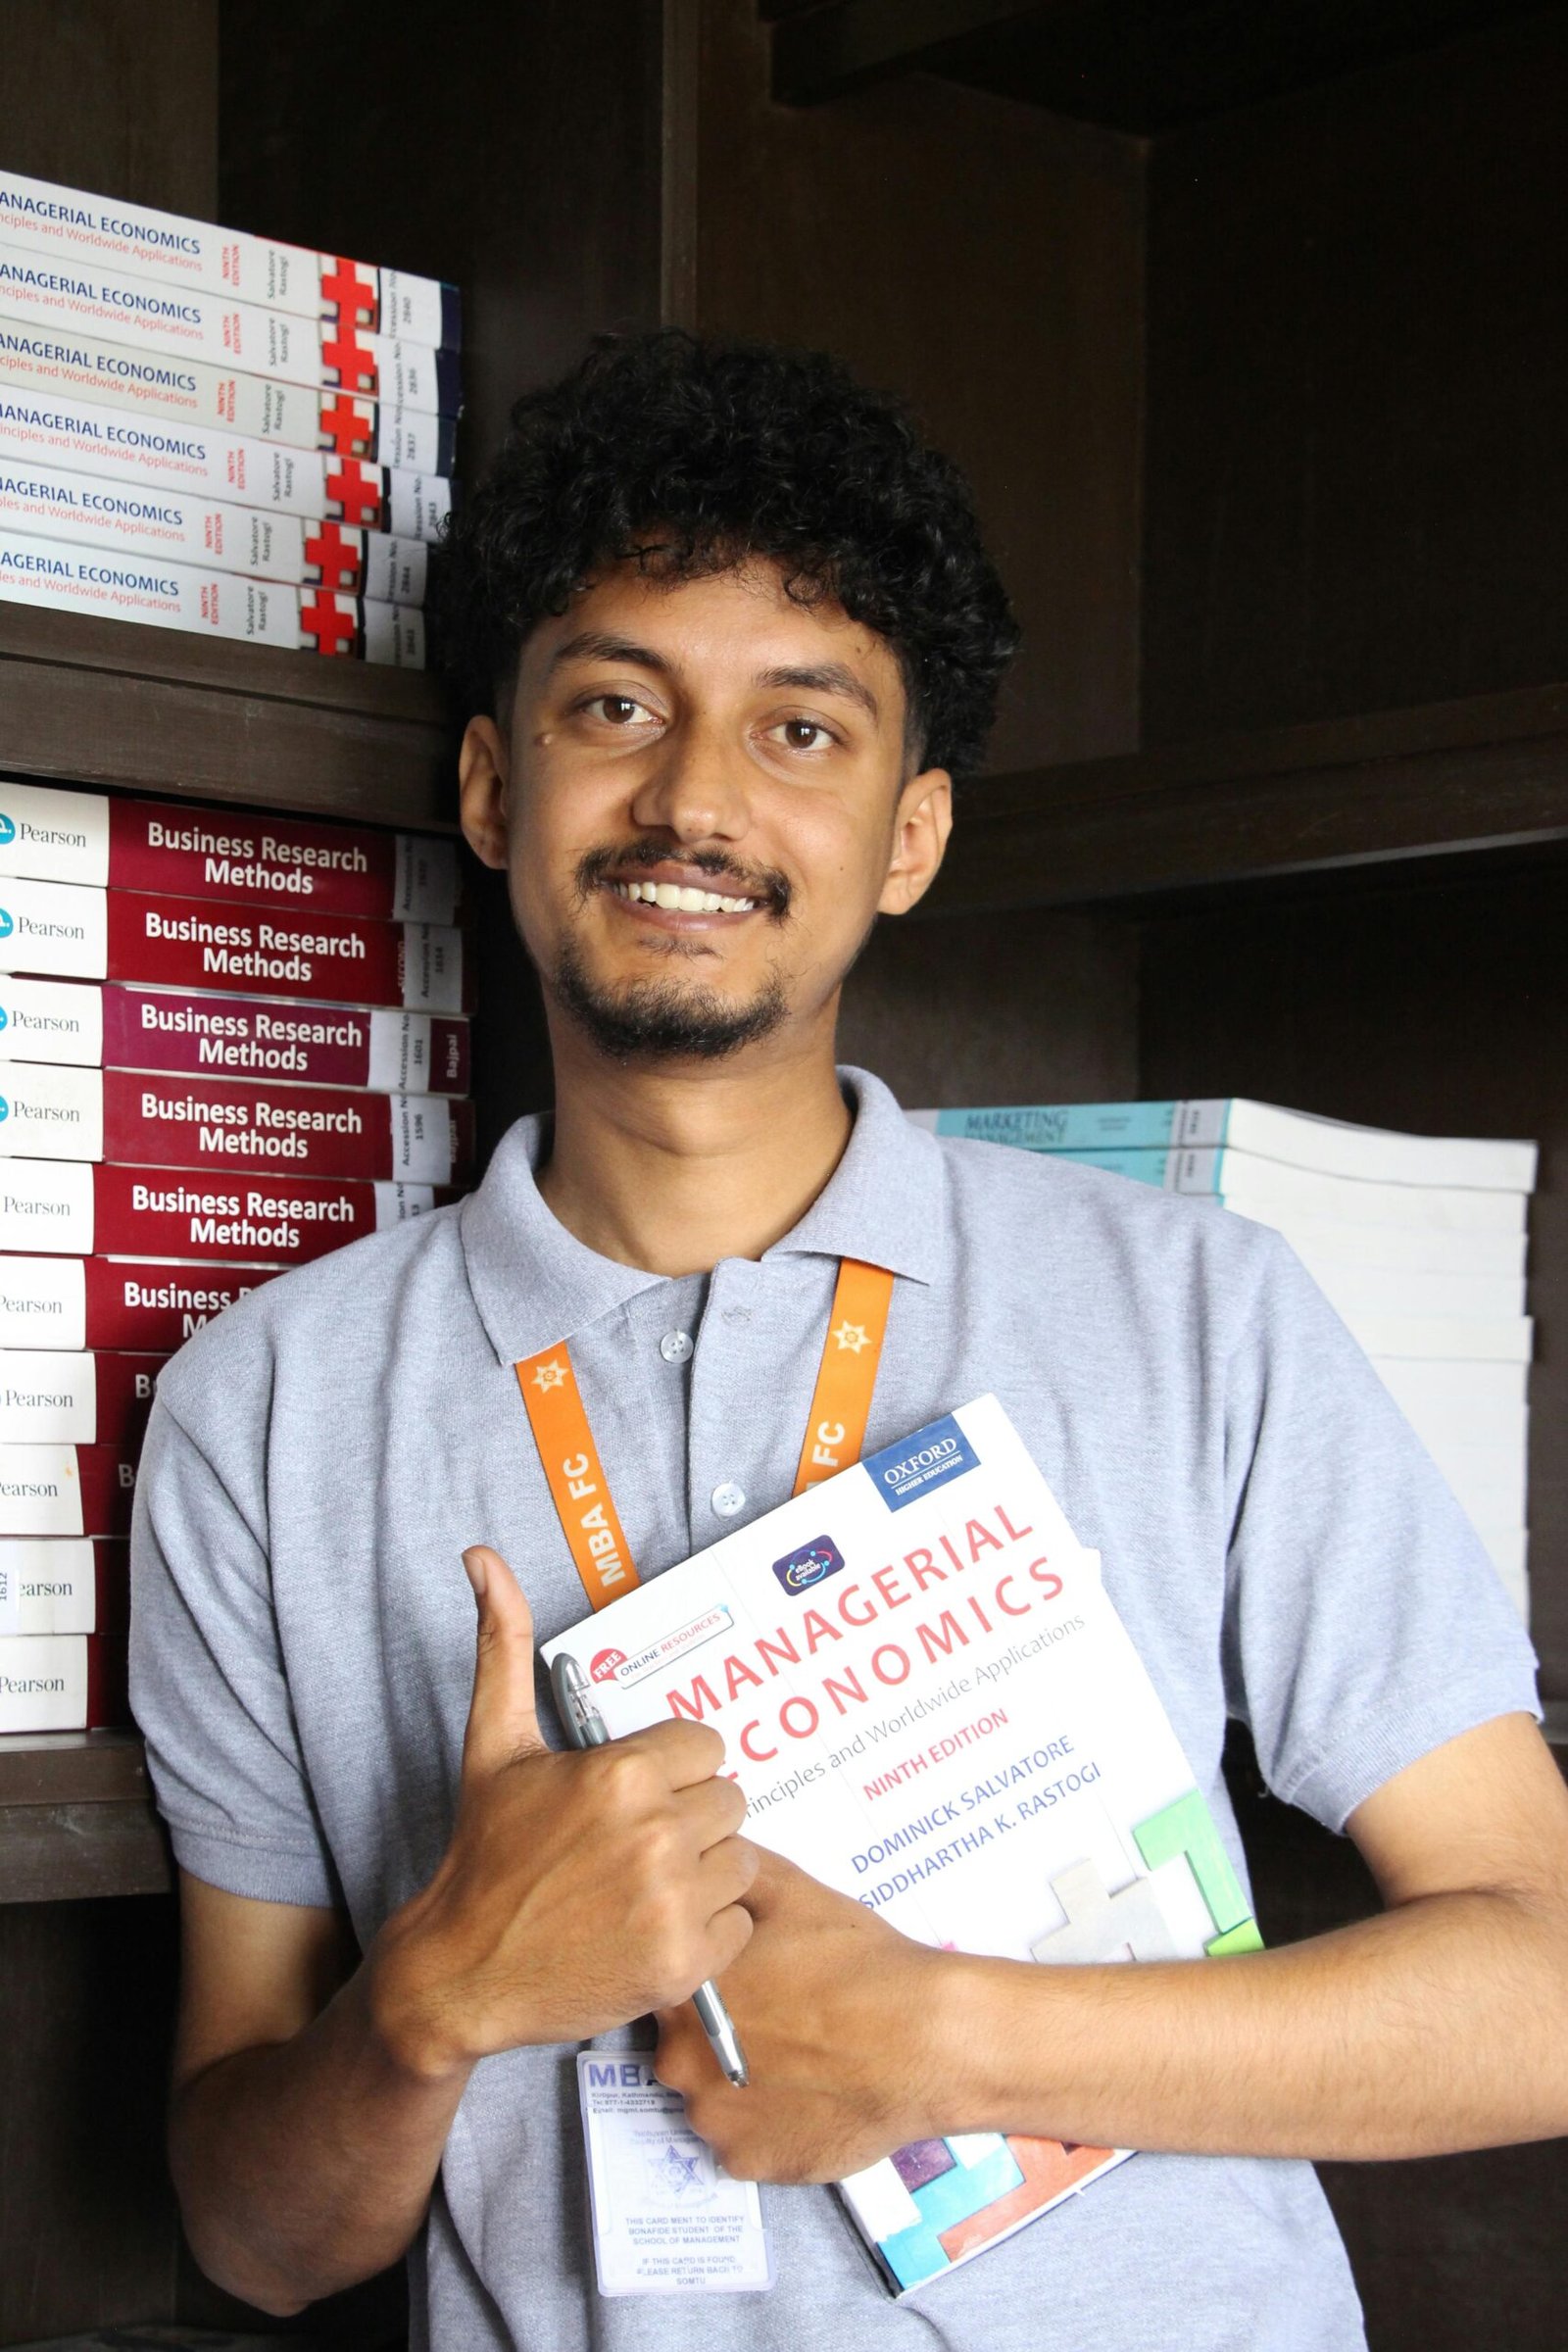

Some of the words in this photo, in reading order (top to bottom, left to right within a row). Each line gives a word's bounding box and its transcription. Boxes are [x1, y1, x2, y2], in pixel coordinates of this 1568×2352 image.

[0, 191, 96, 229] ANAGERIAL
[101, 217, 201, 255] ECONOMICS
[41, 222, 64, 237] and
[66, 228, 129, 253] Worldwide
[132, 244, 203, 272] Applications
[221, 246, 230, 279] NINTH
[231, 244, 240, 287] EDITION
[0, 263, 97, 300] ANAGERIAL
[102, 287, 201, 323] ECONOMICS
[267, 249, 275, 300] Salvatore
[279, 256, 290, 296] Rastogi
[42, 295, 66, 309] and
[68, 300, 131, 324] Worldwide
[133, 315, 204, 341] Applications
[222, 316, 231, 347] NINTH
[232, 313, 242, 355] EDITION
[0, 332, 92, 368] ANAGERIAL
[96, 355, 196, 392] ECONOMICS
[280, 323, 291, 364] Rastogi
[36, 363, 59, 377] and
[61, 368, 125, 392] Worldwide
[127, 383, 198, 409] Applications
[217, 382, 225, 416] NINTH
[226, 379, 236, 422] EDITION
[262, 383, 271, 434] Salvatore
[274, 390, 286, 431] Rastogi
[47, 433, 71, 449] and
[73, 439, 136, 462] Worldwide
[138, 453, 209, 477] Applications
[107, 425, 207, 461] ECONOMICS
[237, 448, 246, 490] EDITION
[272, 452, 281, 502] Salvatore
[284, 458, 295, 498] Rastogi
[23, 502, 45, 516] and
[48, 506, 112, 529] Worldwide
[115, 519, 185, 543] Applications
[82, 493, 183, 525] ECONOMICS
[204, 515, 213, 549] NINTH
[215, 513, 223, 555] EDITION
[250, 516, 259, 565] Salvatore
[262, 521, 273, 563] Rastogi
[0, 551, 74, 578] AGERIAL
[78, 564, 179, 597] ECONOMICS
[18, 574, 41, 588] and
[43, 578, 108, 601] Worldwide
[110, 590, 181, 613] Applications
[200, 585, 209, 619] NINTH
[211, 582, 220, 625] EDITION
[246, 586, 255, 636] Salvatore
[259, 591, 270, 631] Rastogi
[20, 822, 87, 848] Pearson
[148, 821, 255, 859] Business
[261, 836, 368, 872] Research
[205, 858, 314, 895] Methods
[18, 916, 85, 940] Pearson
[145, 911, 252, 948] Business
[259, 924, 366, 959] Research
[203, 947, 313, 981] Methods
[12, 1009, 80, 1033] Pearson
[141, 1004, 249, 1038] Business
[255, 1013, 362, 1047] Research
[199, 1038, 309, 1072] Methods
[399, 1033, 409, 1090] Accession
[414, 1039, 423, 1066] 1601
[446, 1033, 459, 1079] Bajpai
[13, 1100, 80, 1122] Pearson
[141, 1093, 249, 1126] Business
[255, 1102, 363, 1134] Research
[415, 1113, 424, 1141] 1596
[199, 1127, 309, 1158] Methods
[402, 1111, 411, 1166] Accession
[4, 1196, 71, 1216] Pearson
[132, 1184, 240, 1216] Business
[247, 1192, 355, 1222] Research
[190, 1217, 300, 1249] Methods
[123, 1281, 231, 1311] Business
[5, 1389, 74, 1408] Pearson
[811, 1421, 846, 1467] FC
[884, 1438, 957, 1486] OXFORD
[0, 1483, 58, 1497] earson
[563, 1452, 597, 1500] FC
[896, 1476, 926, 1496] HIGHER
[923, 1454, 963, 1482] EDUCATION
[580, 1502, 626, 1588] MBA
[795, 1558, 815, 1574] eBook
[796, 1562, 822, 1582] available
[665, 1504, 1034, 1722] MANAGERIAL
[593, 1650, 622, 1680] FREE
[619, 1649, 662, 1678] ONLINE
[661, 1612, 722, 1654] RESOURCES
[0, 1676, 65, 1693] Pearson
[723, 1555, 1064, 1780] CONOMICS
[828, 1735, 867, 1770] and
[866, 1676, 973, 1744] Worldwide
[973, 1615, 1086, 1687] Applications
[862, 1754, 928, 1802] NINTH
[927, 1707, 1010, 1765] EDITION
[851, 1800, 961, 1875] DOMINICK
[959, 1734, 1075, 1812] SALVATORE
[858, 1824, 995, 1910] SIDDHARTHA
[993, 1810, 1018, 1834] K.
[1016, 1760, 1102, 1821] RASTOGI
[625, 2217, 644, 2226] THIS
[708, 2215, 745, 2224] IDENTIFY
[628, 2227, 670, 2235] BONAFIDE
[672, 2226, 710, 2234] STUDENT
[633, 2236, 667, 2245] SCHOOL
[683, 2234, 741, 2244] MANAGEMENT
[676, 2277, 706, 2285] SOMTU
